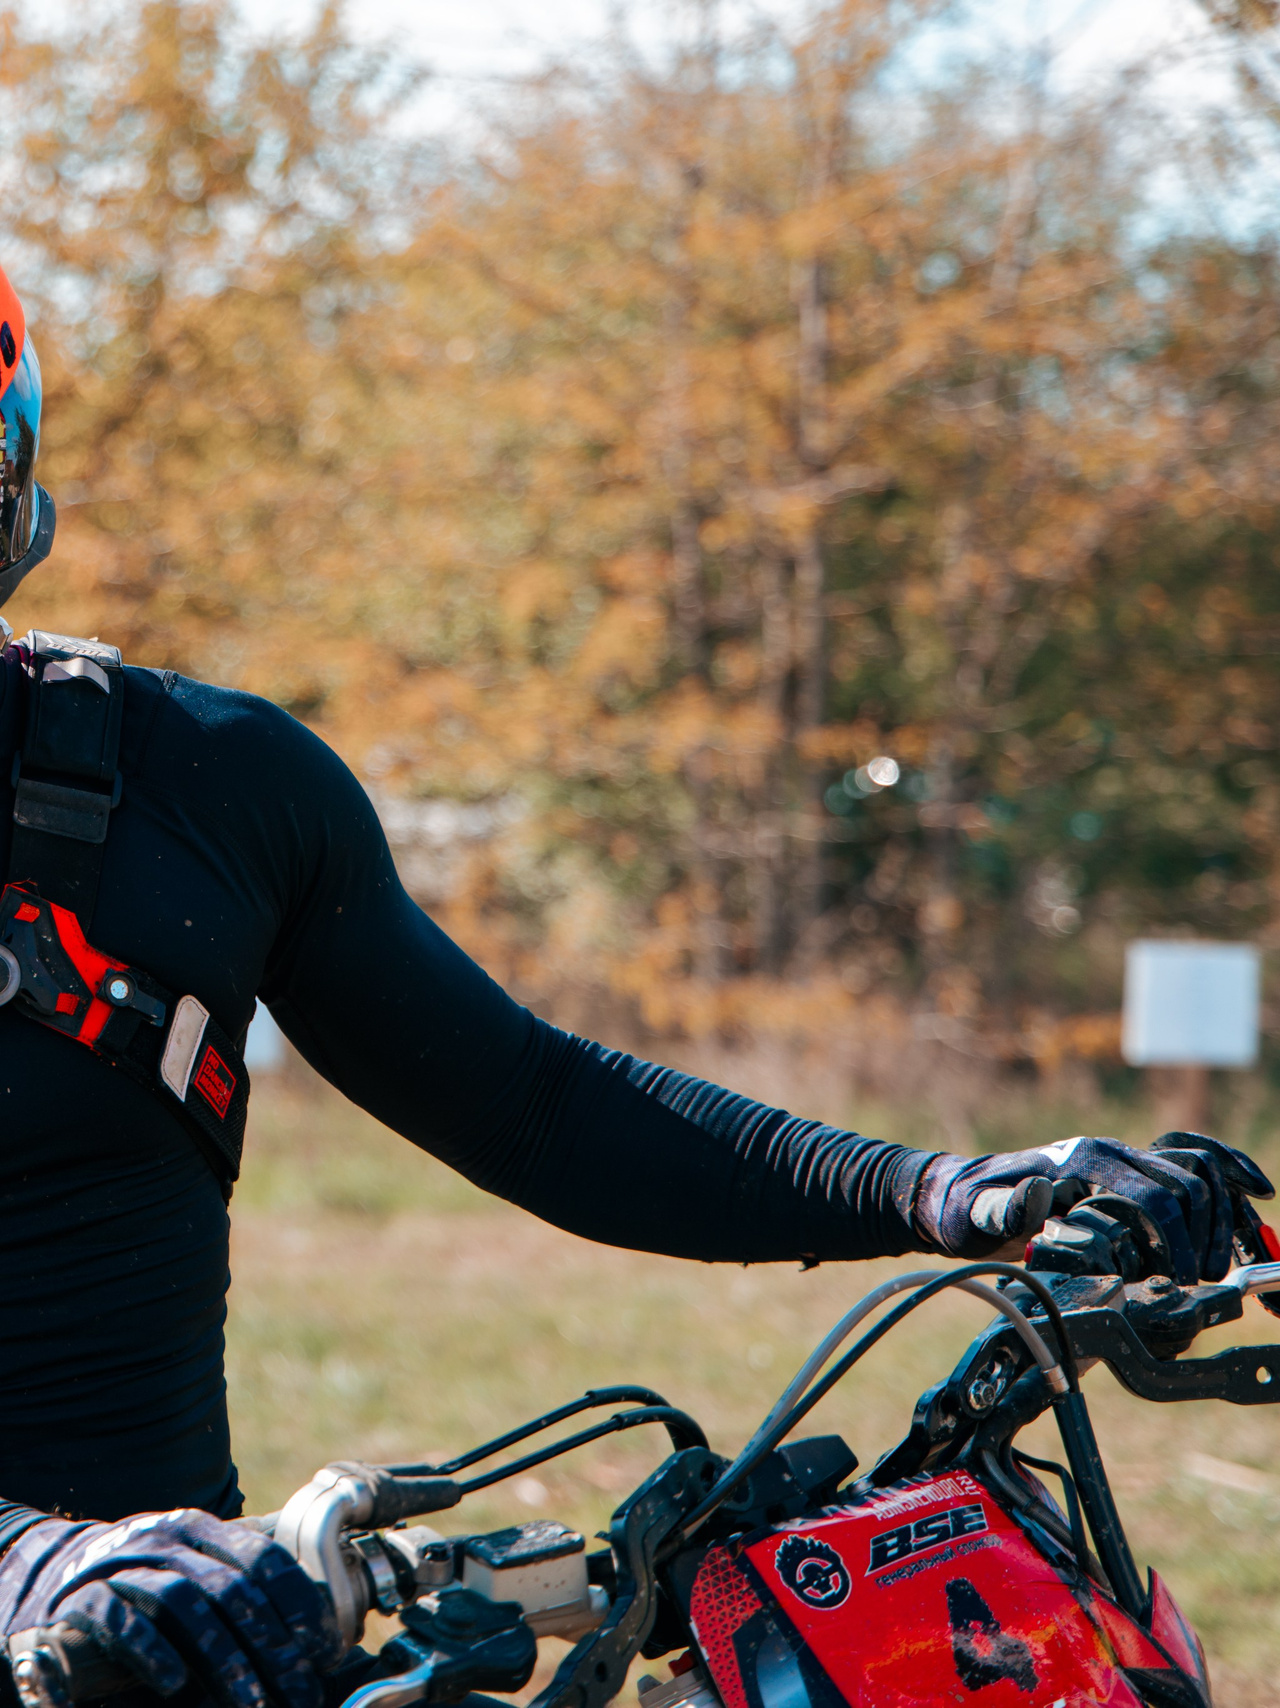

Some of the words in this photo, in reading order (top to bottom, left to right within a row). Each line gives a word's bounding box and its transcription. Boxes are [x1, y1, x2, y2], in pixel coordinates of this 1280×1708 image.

[207, 1053, 220, 1070] NO
[199, 1074, 227, 1108] MONKEY
[864, 1503, 989, 1577] BSE
[875, 1545, 958, 1589] генеральный
[956, 1533, 1003, 1556] спонсор
